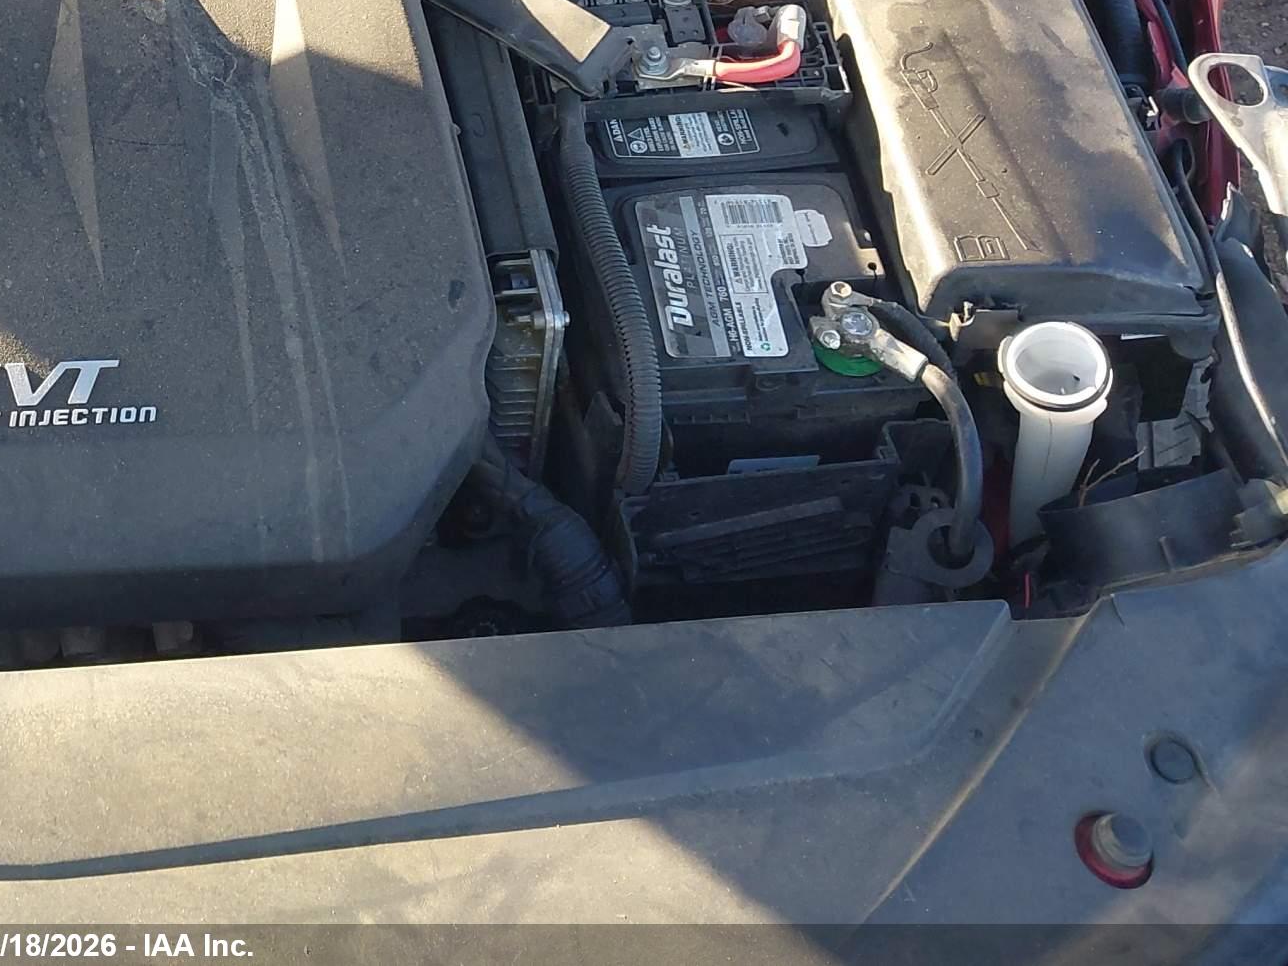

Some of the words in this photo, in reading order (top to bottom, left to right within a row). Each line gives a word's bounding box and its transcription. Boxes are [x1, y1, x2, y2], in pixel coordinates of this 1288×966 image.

[690, 229, 713, 300] TECHNOLOGY
[646, 224, 695, 331] Duralast
[717, 286, 729, 303] 760
[708, 303, 721, 327] AGM
[9, 406, 158, 428] INJECTION
